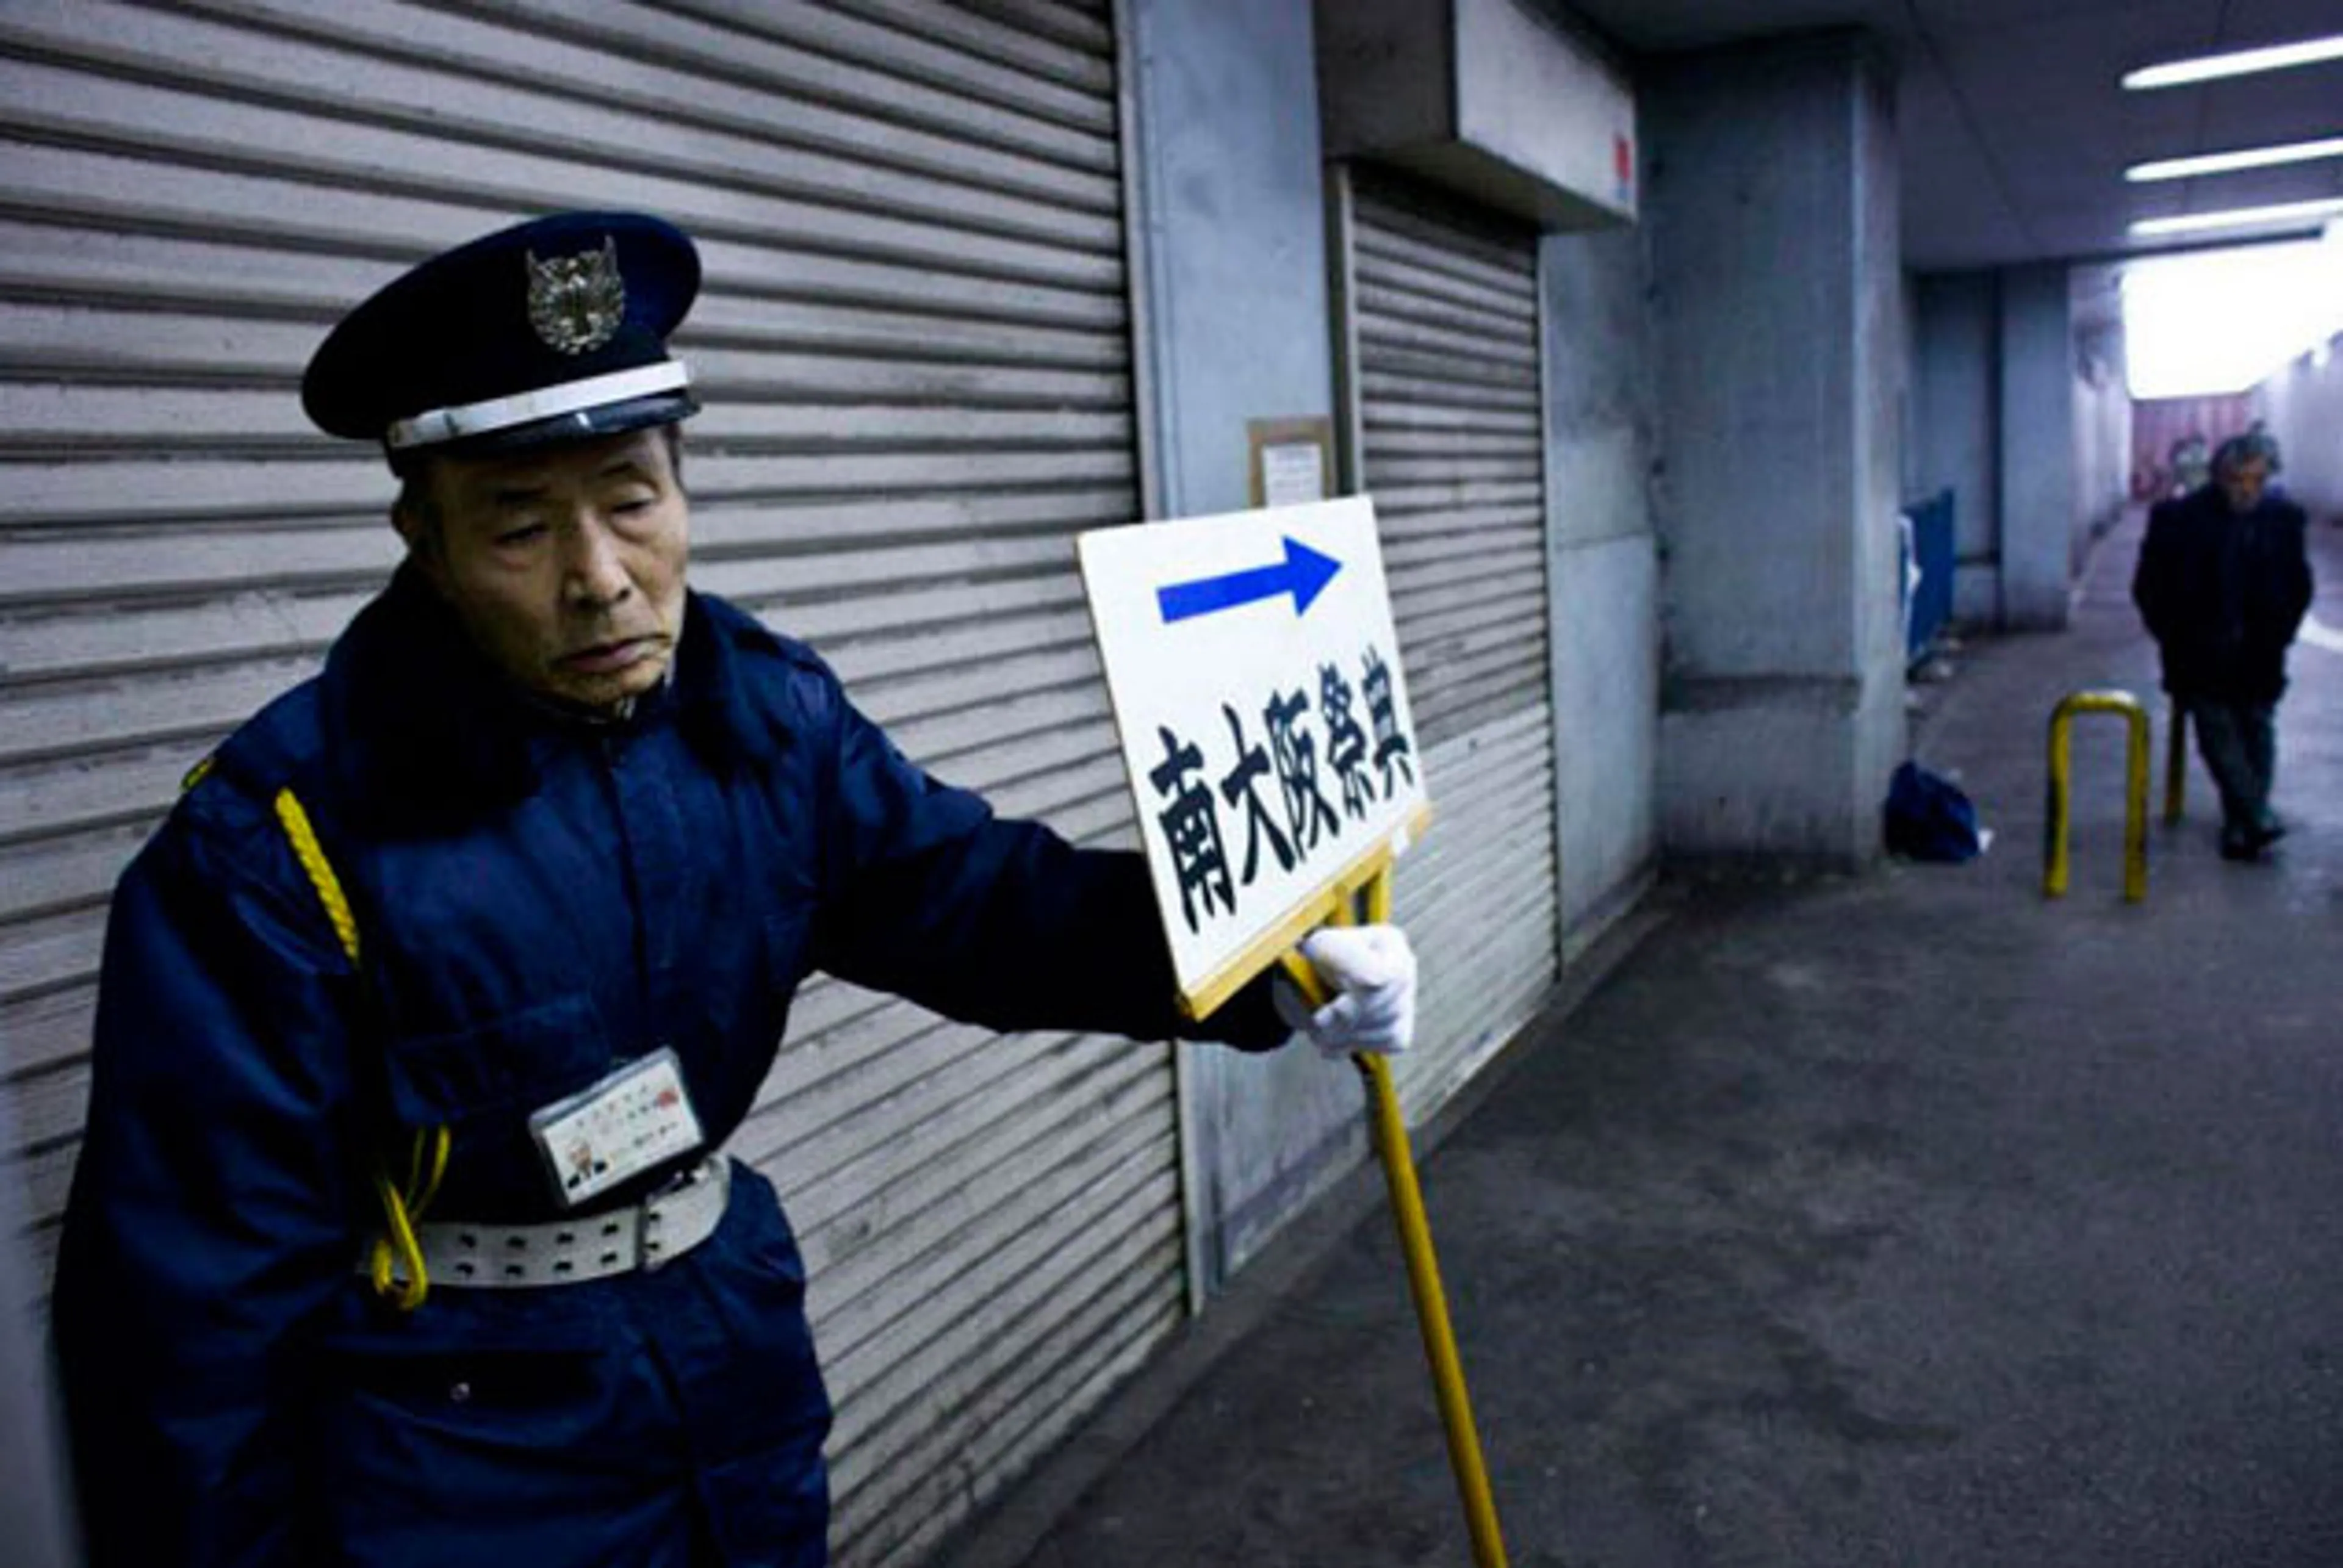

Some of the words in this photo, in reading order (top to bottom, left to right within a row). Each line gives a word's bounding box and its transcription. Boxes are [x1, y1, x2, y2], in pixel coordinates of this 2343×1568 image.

[1150, 644, 1413, 935] 南大阪祭典
